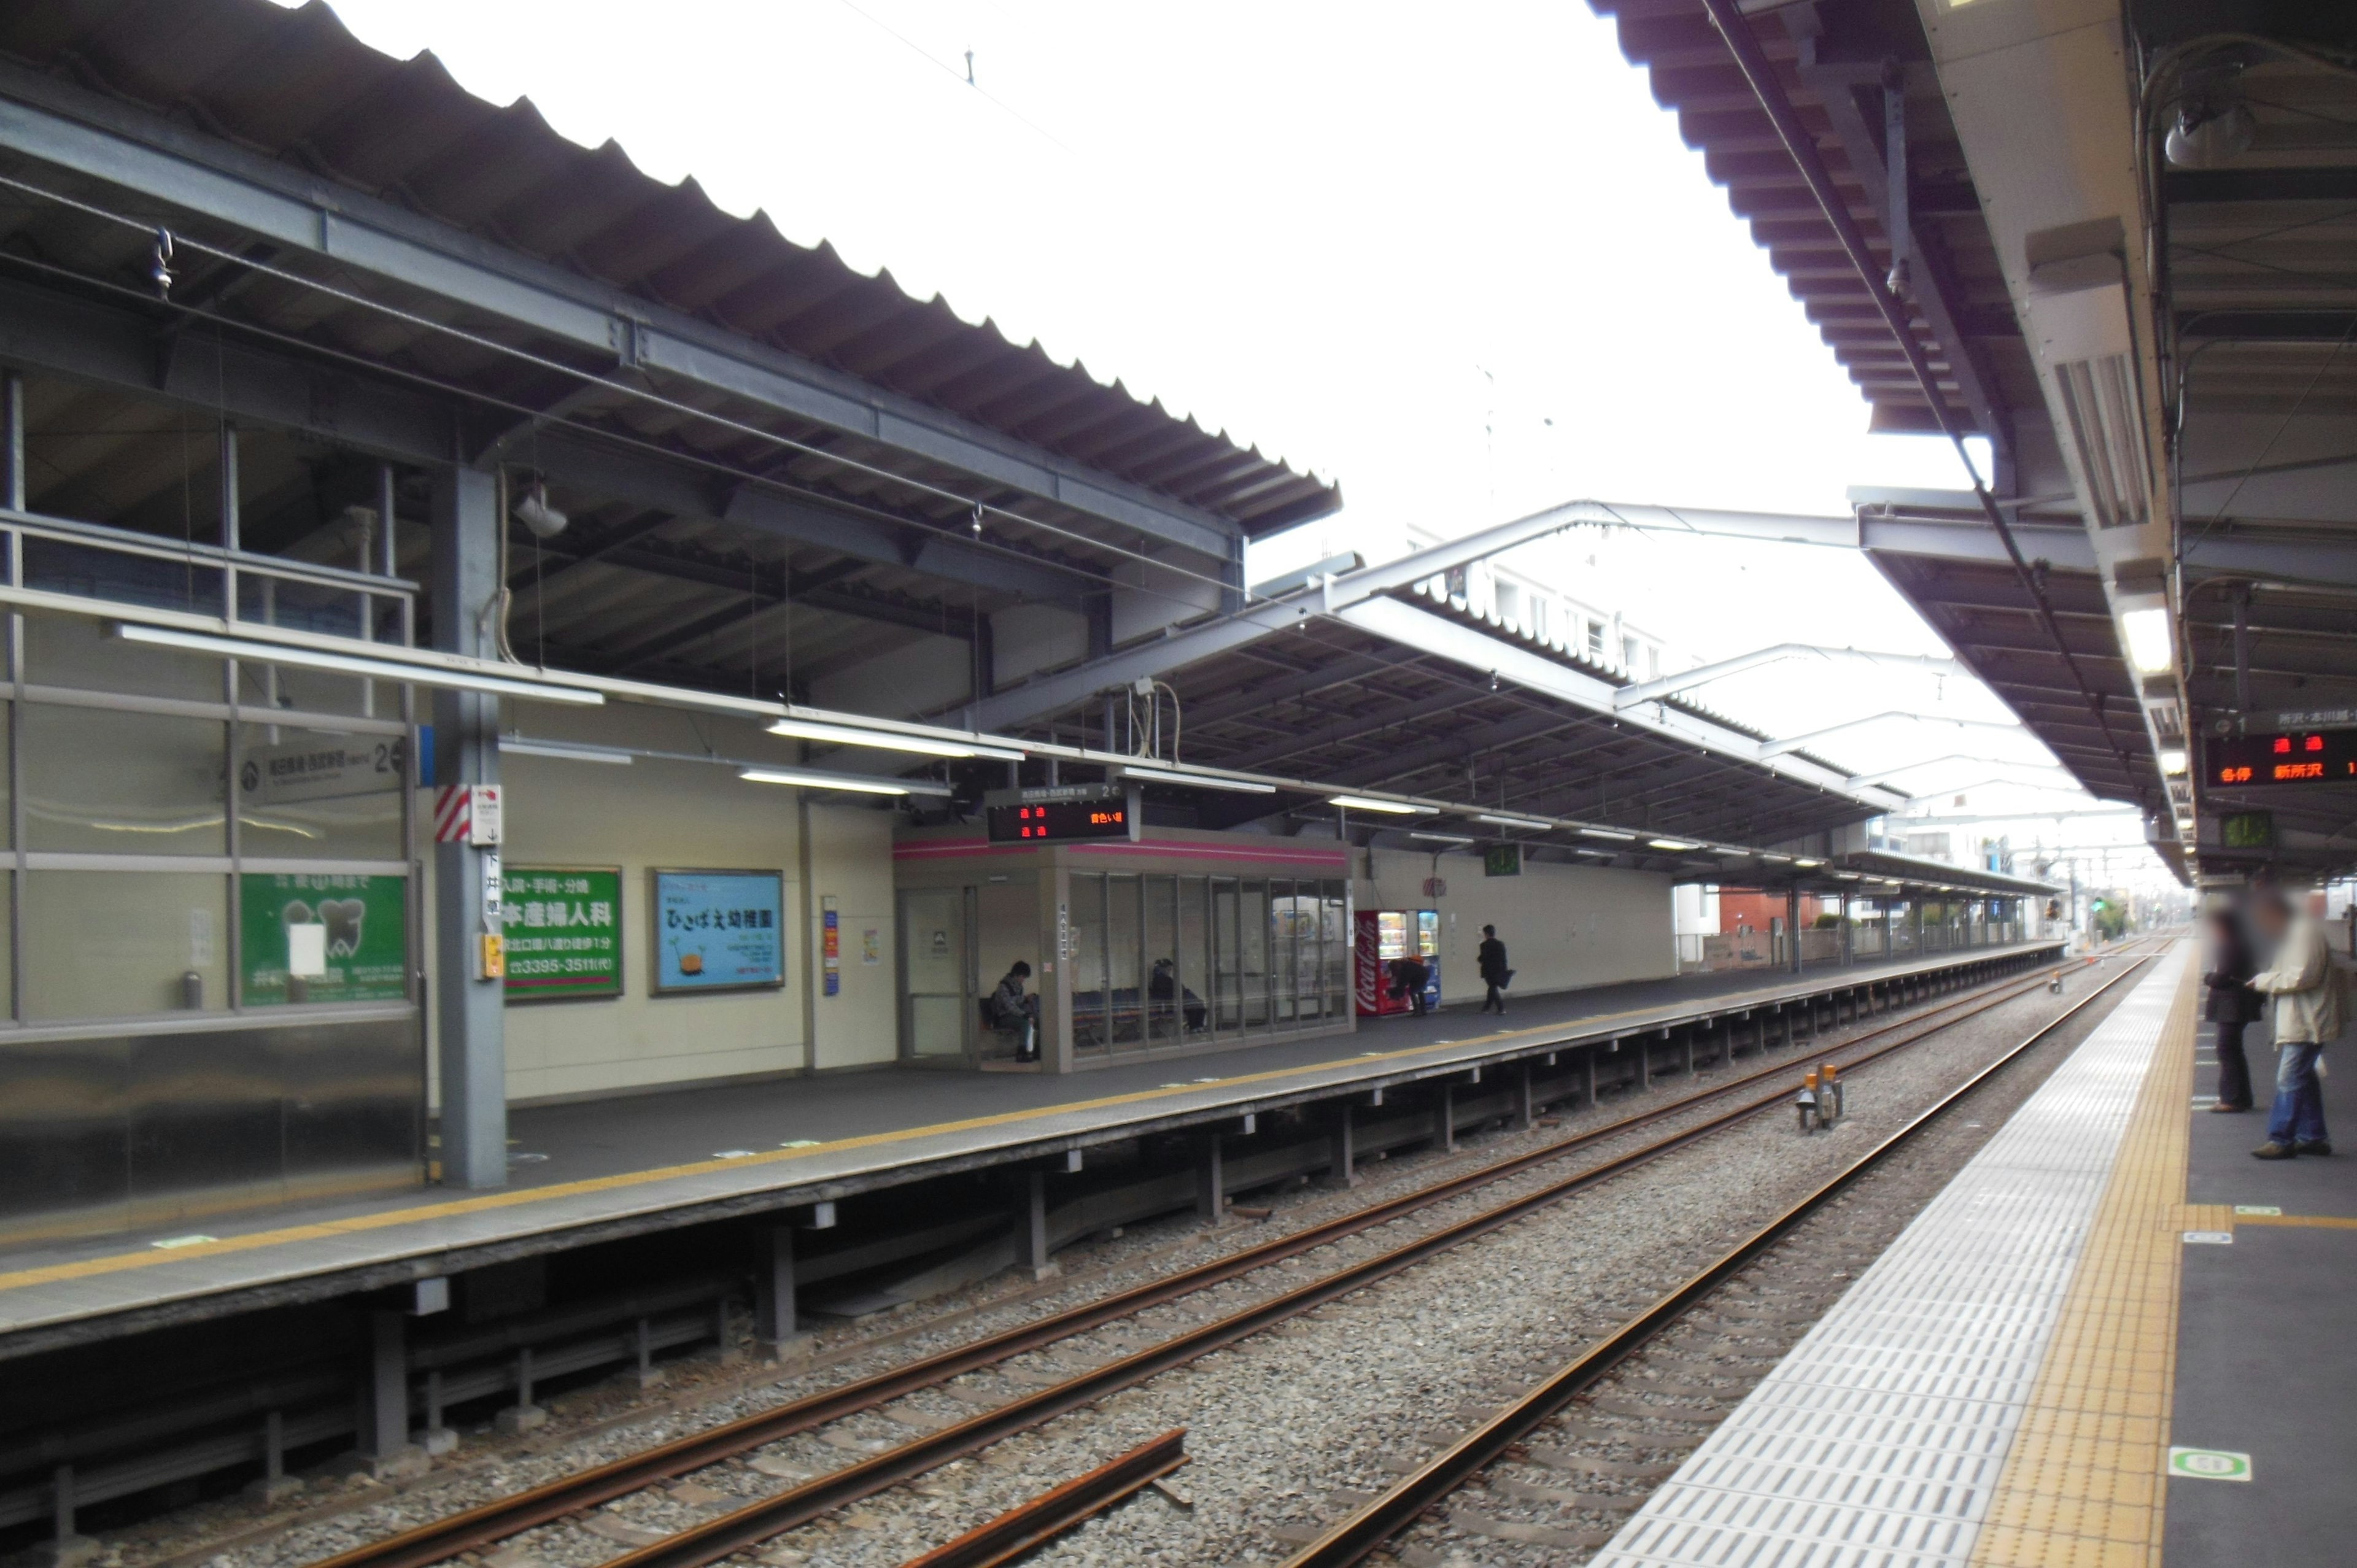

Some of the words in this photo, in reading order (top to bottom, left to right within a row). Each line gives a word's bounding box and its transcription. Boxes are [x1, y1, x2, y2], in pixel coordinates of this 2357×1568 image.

[2237, 717, 2246, 733] 1
[2279, 709, 2357, 725] 所沢・本川越・
[374, 743, 389, 773] 2
[2274, 763, 2323, 779] 新所沢
[1102, 786, 1110, 797] 2
[487, 853, 500, 913] 下井草
